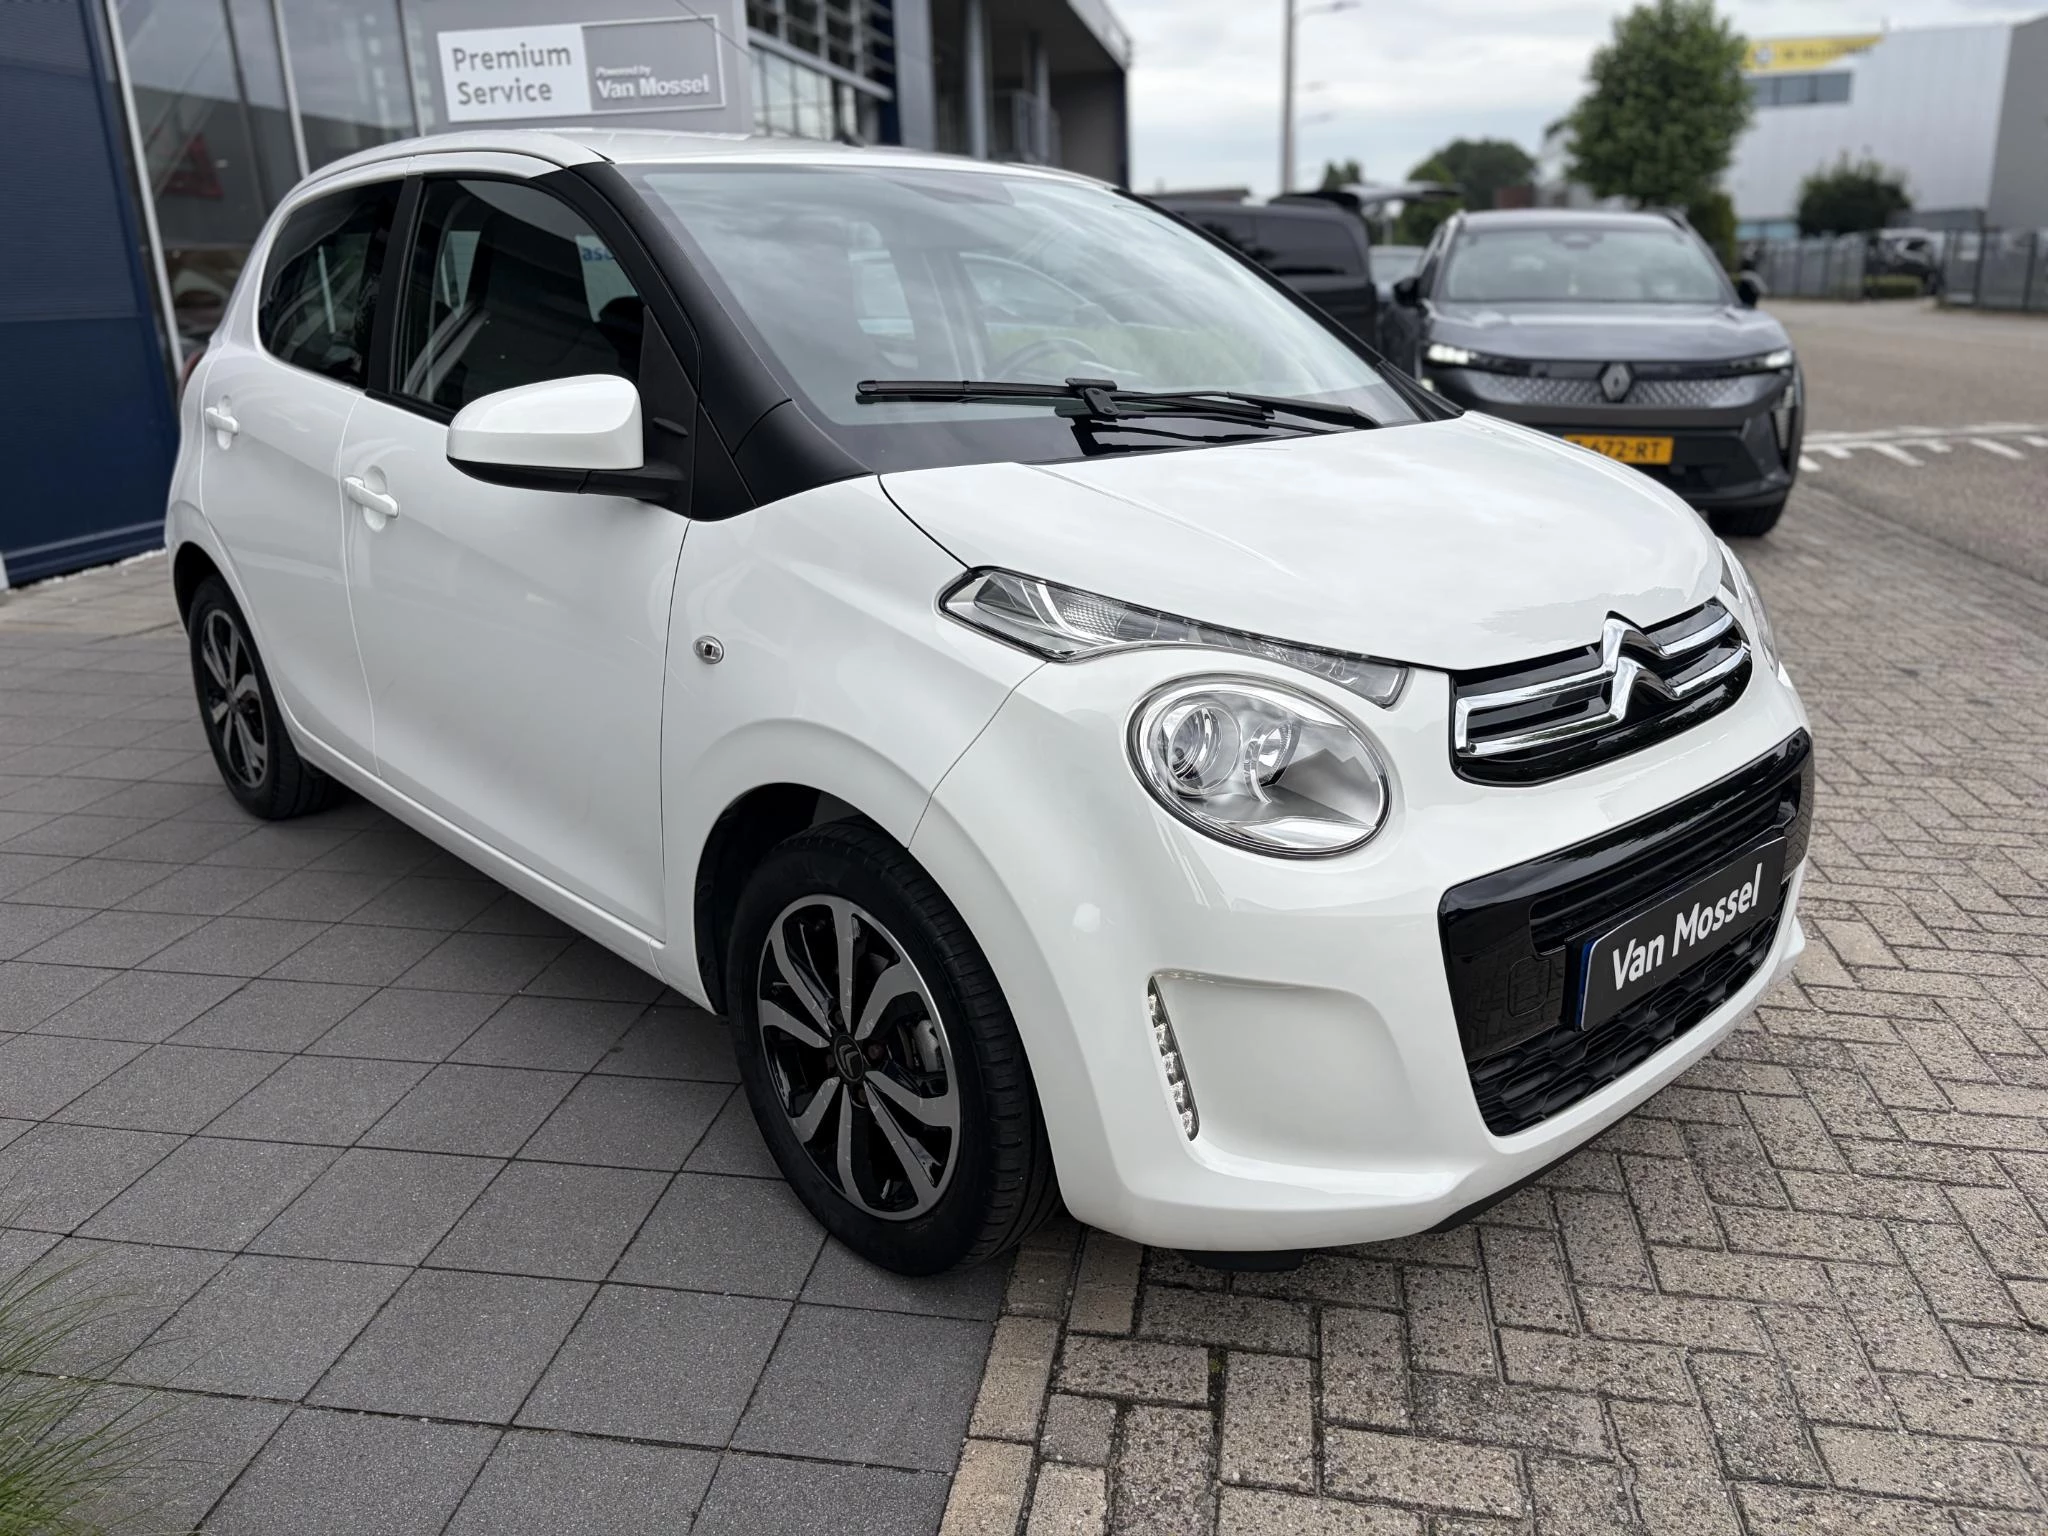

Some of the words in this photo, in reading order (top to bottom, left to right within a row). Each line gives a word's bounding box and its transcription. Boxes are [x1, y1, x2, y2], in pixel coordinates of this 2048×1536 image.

[452, 42, 572, 72] Premium
[457, 78, 553, 105] Service
[597, 80, 635, 99] Van
[639, 74, 710, 97] Mossel
[1612, 934, 1665, 991] Van
[1671, 862, 1763, 958] Mossel
